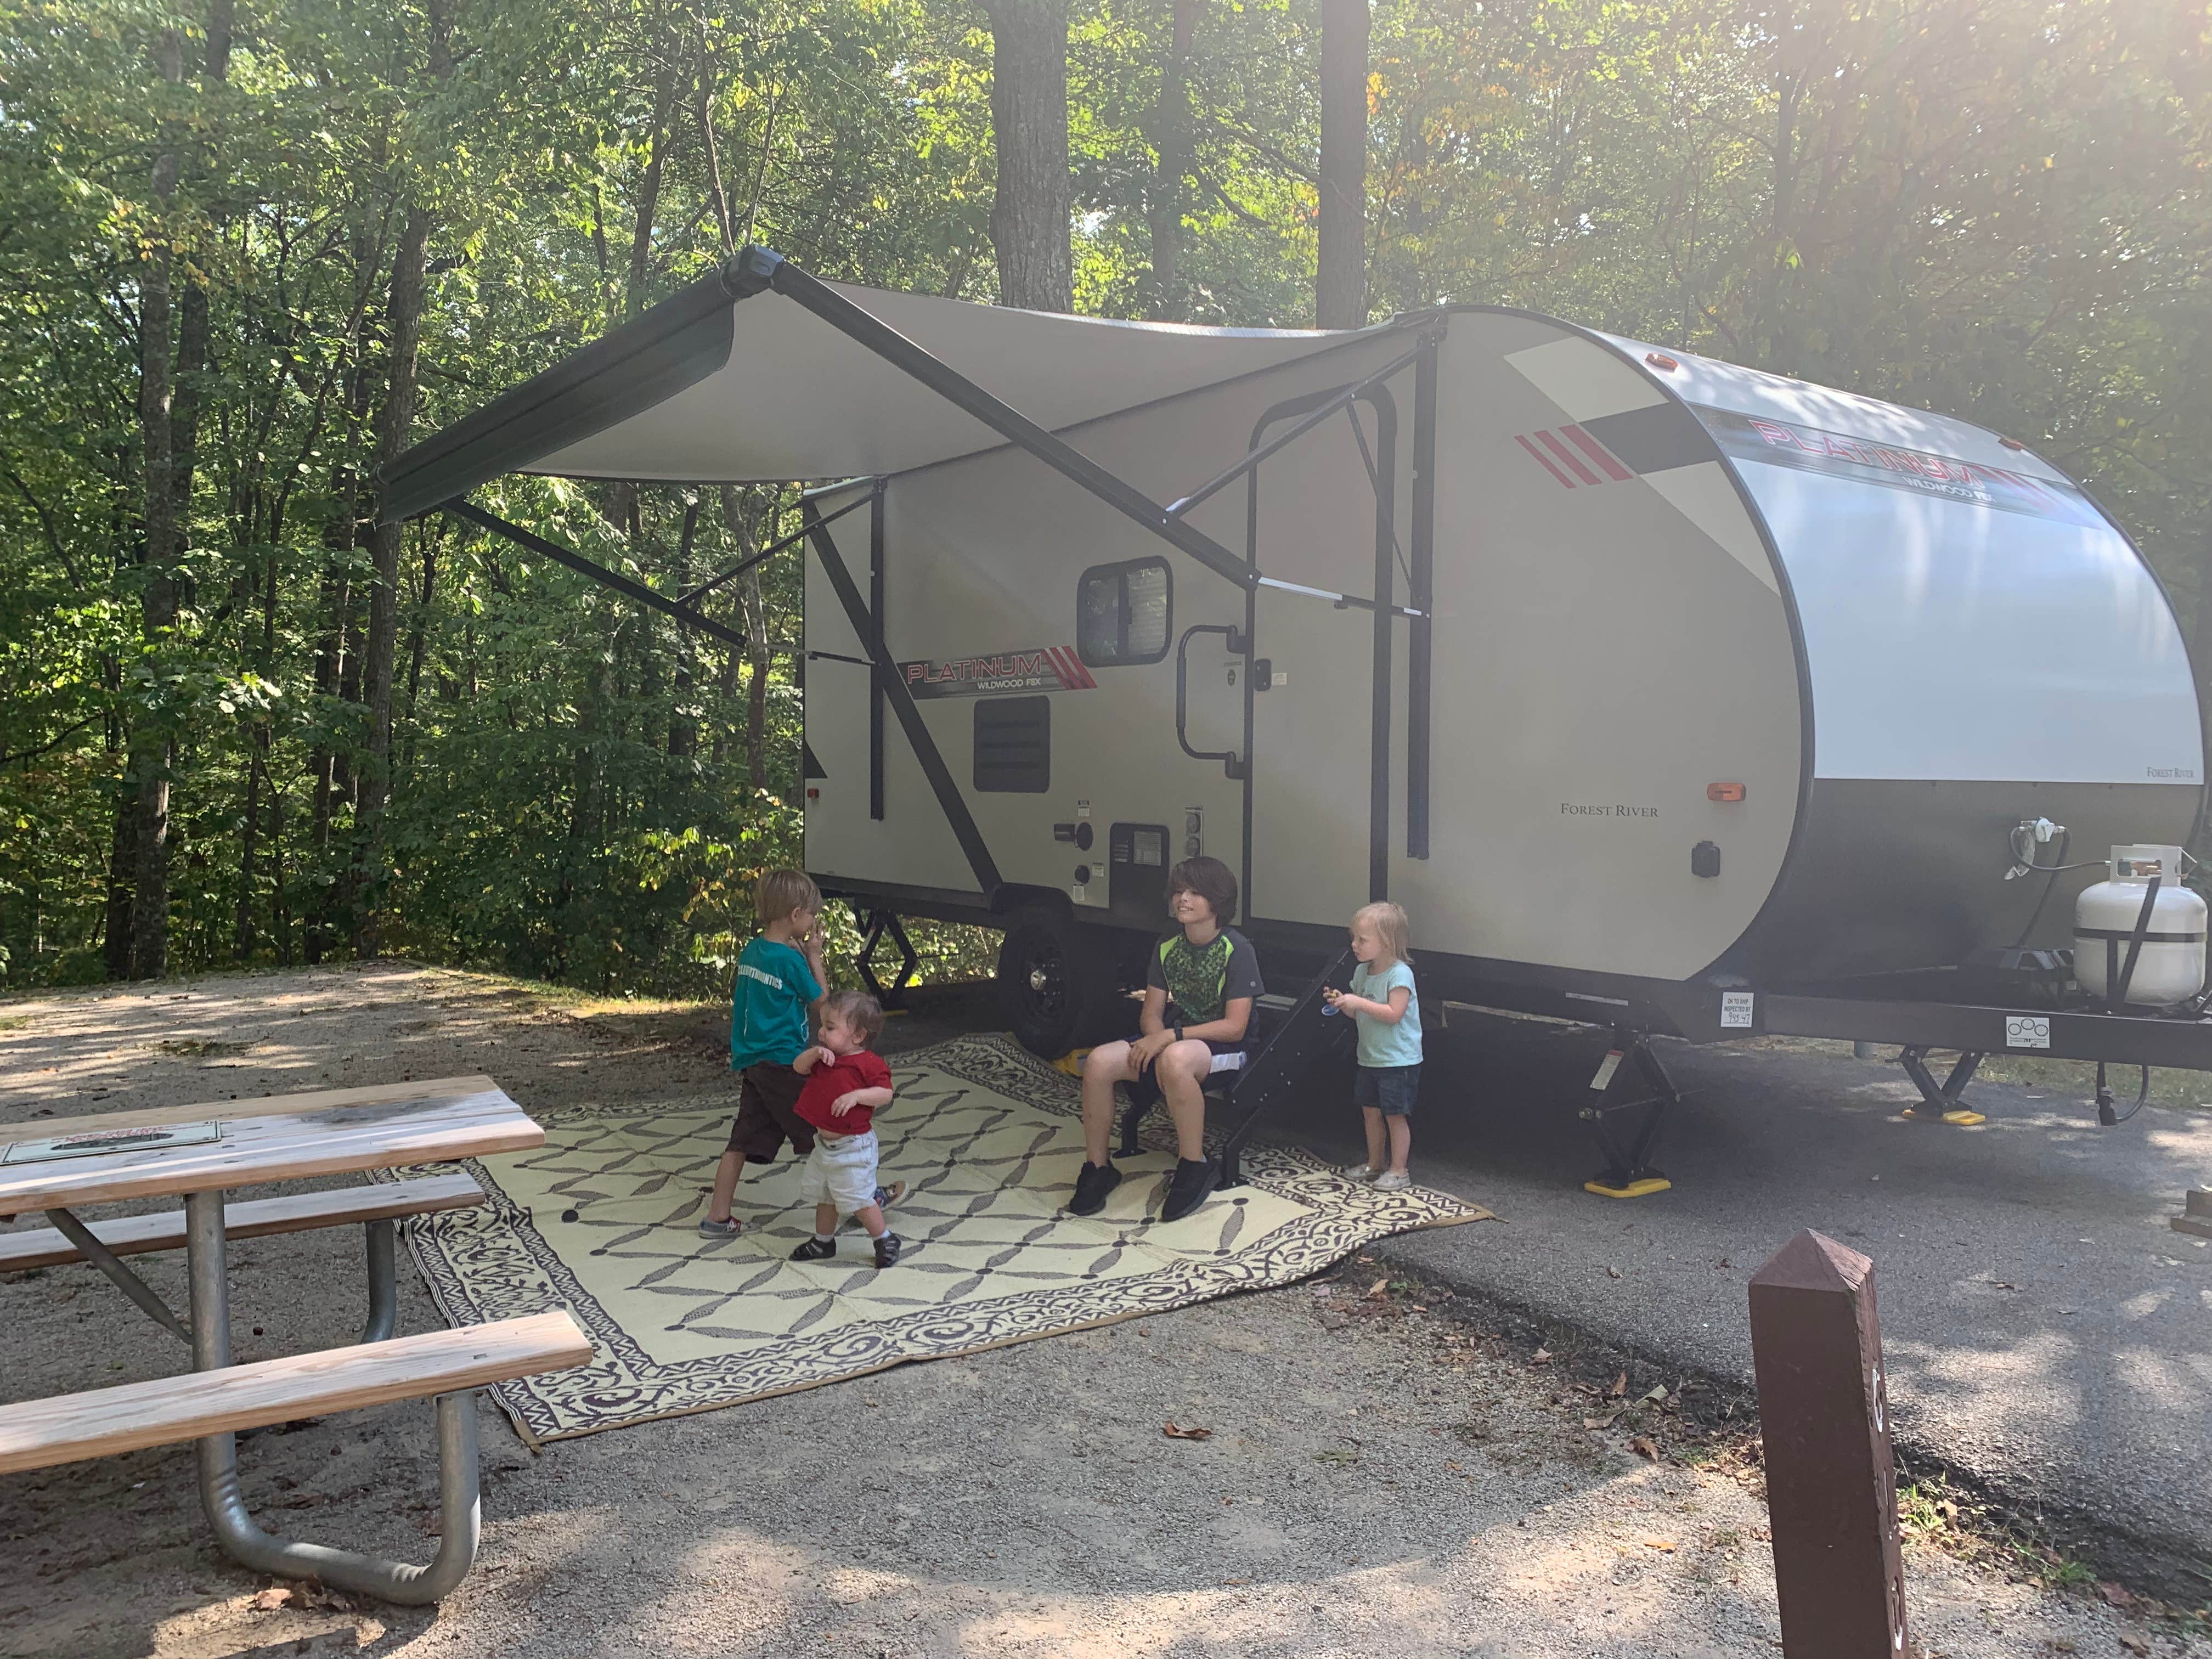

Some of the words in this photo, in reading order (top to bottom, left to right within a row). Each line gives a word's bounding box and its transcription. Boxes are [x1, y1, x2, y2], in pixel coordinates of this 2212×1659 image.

[1748, 419, 1985, 489] PLATINUM
[1902, 476, 1973, 498] WILDWOOD
[907, 653, 1041, 685] PLATINUM
[978, 679, 1024, 690] WILDWOOD
[1560, 803, 1612, 816] FOREST
[1616, 805, 1659, 817] RIVER
